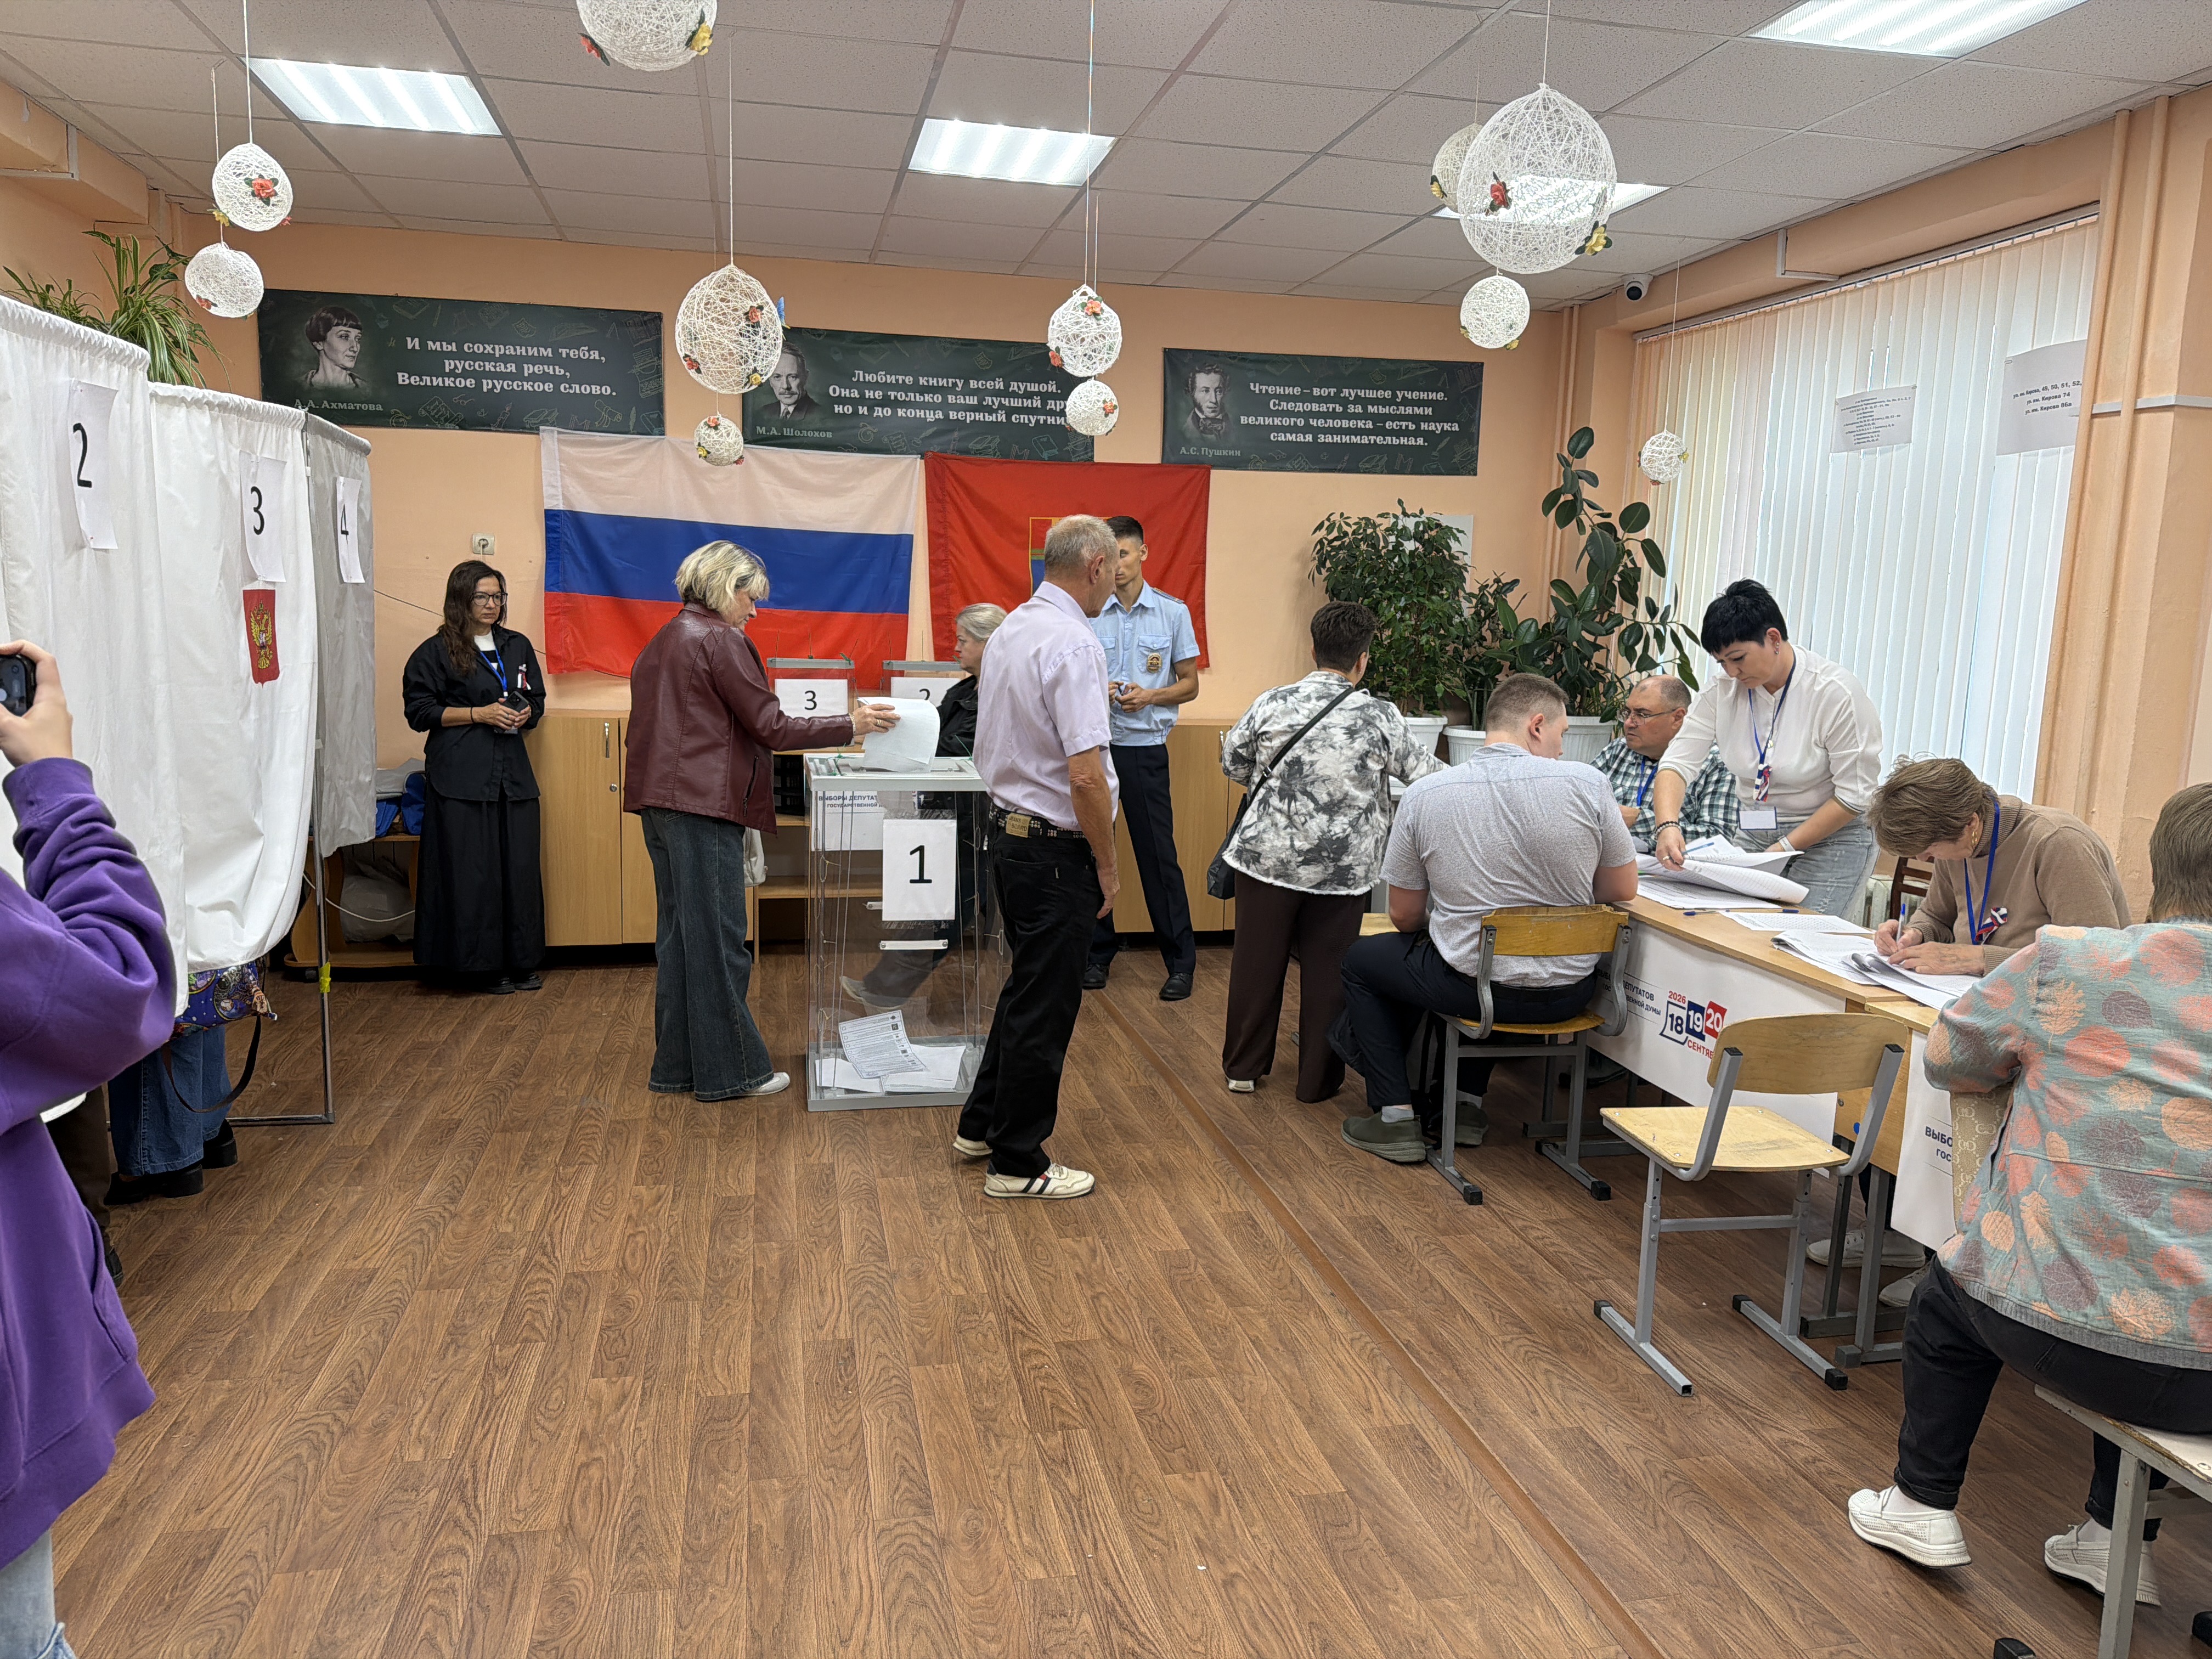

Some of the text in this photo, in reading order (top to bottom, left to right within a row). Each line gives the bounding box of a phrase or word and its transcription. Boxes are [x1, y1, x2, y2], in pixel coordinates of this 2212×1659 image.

[406, 336, 606, 363] И мы сохраним тебя,
[444, 358, 571, 378] русская речь,
[396, 372, 616, 396] Великое русское слово.
[852, 370, 1062, 394] Любите книгу всей душой.
[1249, 382, 1301, 395] Чтение
[1312, 387, 1337, 397] вот
[1340, 388, 1392, 400] лучшее
[1396, 390, 1448, 402] учение.
[321, 400, 383, 411] Ахматова
[829, 385, 1067, 411] Она не только ваш лучший др
[1269, 399, 1433, 415] Следовать за мыслями
[833, 404, 853, 414] но
[857, 405, 868, 415] и
[873, 407, 891, 417] до
[897, 408, 944, 422] конца
[949, 410, 1007, 424] верный
[756, 426, 832, 438] М.А. Шолохов
[1240, 415, 1305, 426] великого
[1309, 418, 1374, 428] человека
[1385, 421, 1416, 430] есть
[1420, 422, 1460, 434] наука
[1270, 432, 1428, 445] самая занимательная.
[73, 422, 92, 488] 2
[1180, 447, 1241, 458] А.С. Пушкин
[250, 486, 265, 535] 3
[340, 504, 349, 545] 4
[804, 690, 818, 710] 3
[909, 845, 933, 884] 1
[1668, 990, 1686, 1005] 2026
[1645, 1004, 1661, 1016] ДУМЫ
[1669, 1008, 1723, 1035] 18 19 20
